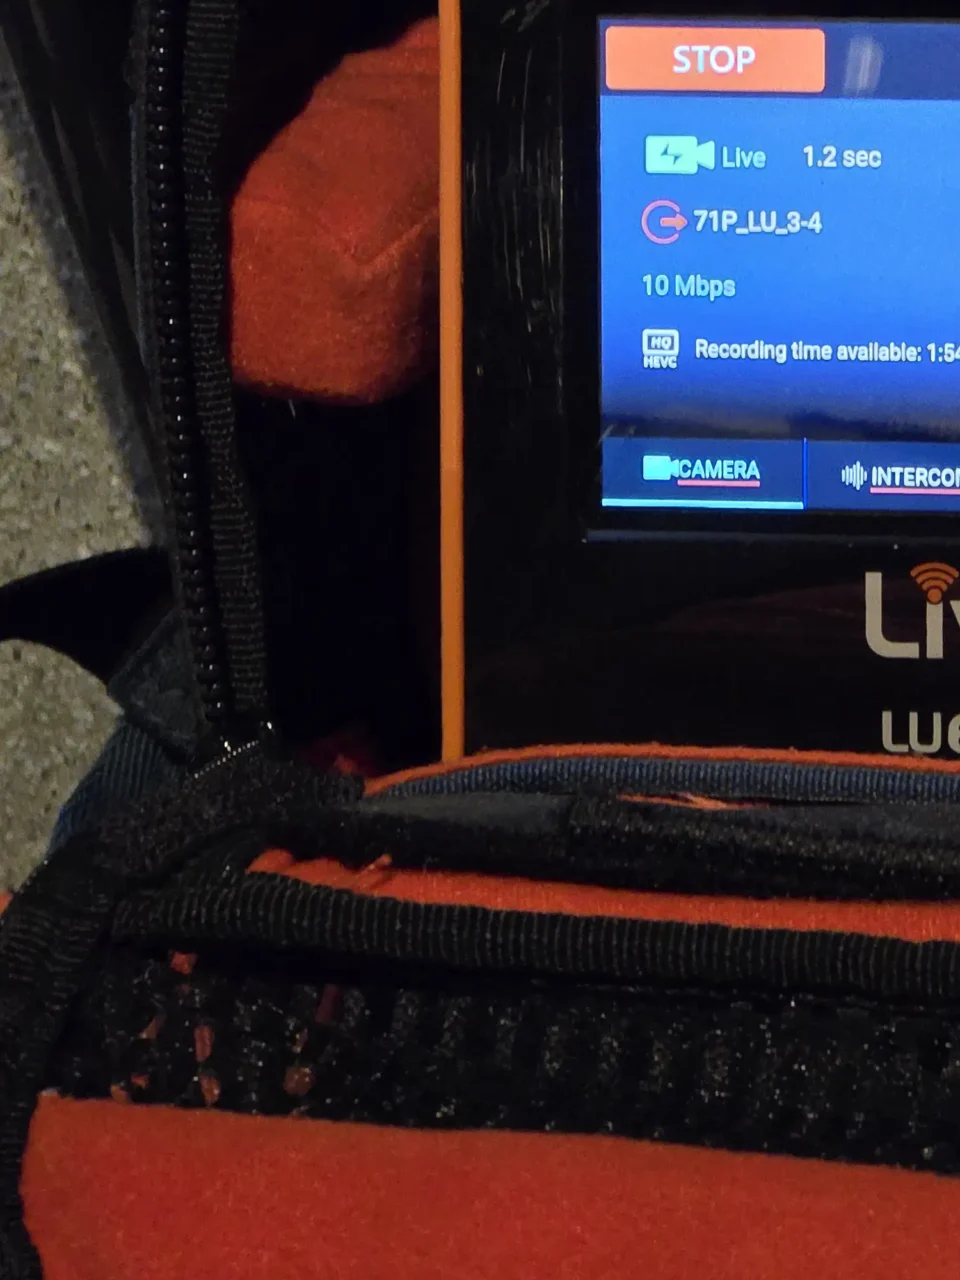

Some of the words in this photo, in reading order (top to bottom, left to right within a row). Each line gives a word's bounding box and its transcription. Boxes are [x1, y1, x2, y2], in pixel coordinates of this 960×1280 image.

[672, 45, 757, 74] STOP
[722, 146, 767, 169] Live
[803, 145, 837, 169] 1.2
[842, 150, 882, 169] sec
[693, 209, 824, 236] 71P_LU_3-4
[642, 275, 669, 297] 10
[675, 276, 737, 301] Mbps
[643, 355, 678, 369] HEVC
[695, 338, 787, 364] Recording
[791, 341, 832, 361] time
[837, 342, 922, 363] available:
[679, 459, 761, 480] CAMERA
